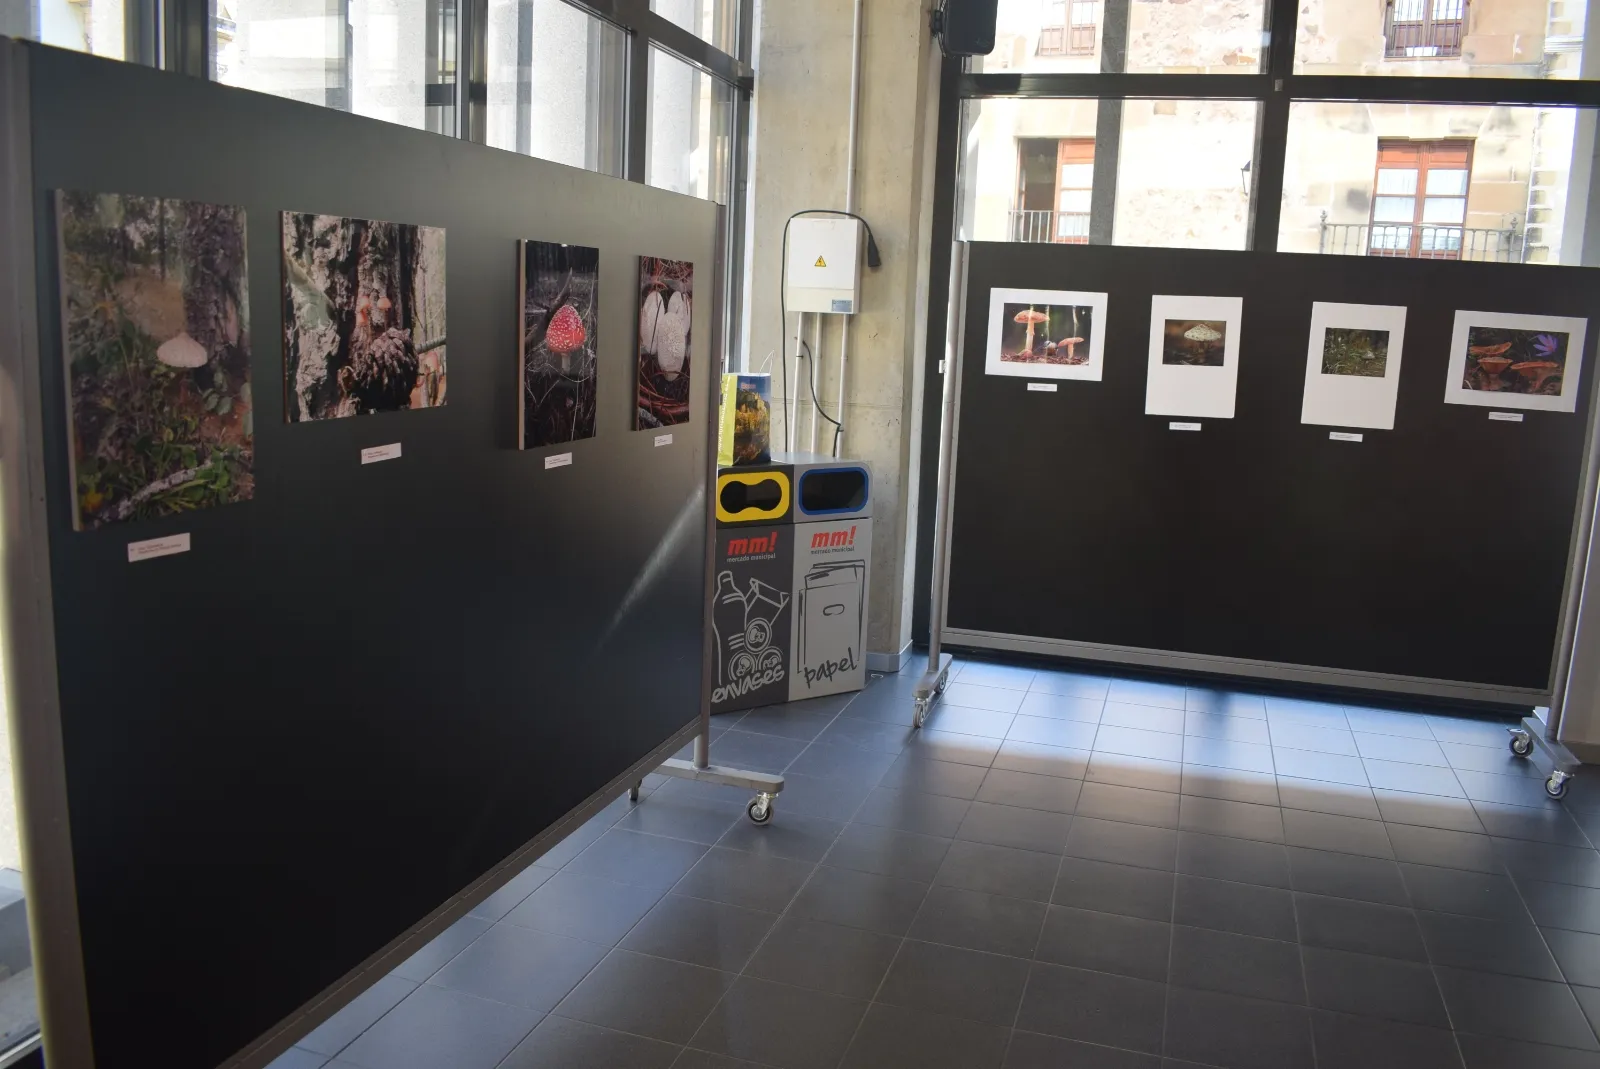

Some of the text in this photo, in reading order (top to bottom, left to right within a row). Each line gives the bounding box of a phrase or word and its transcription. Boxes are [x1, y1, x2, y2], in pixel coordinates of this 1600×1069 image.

[728, 531, 777, 555] mm!
[811, 526, 857, 548] mm!
[727, 552, 776, 563] mercado municipal
[804, 647, 858, 689] papel
[711, 664, 785, 703] envases
